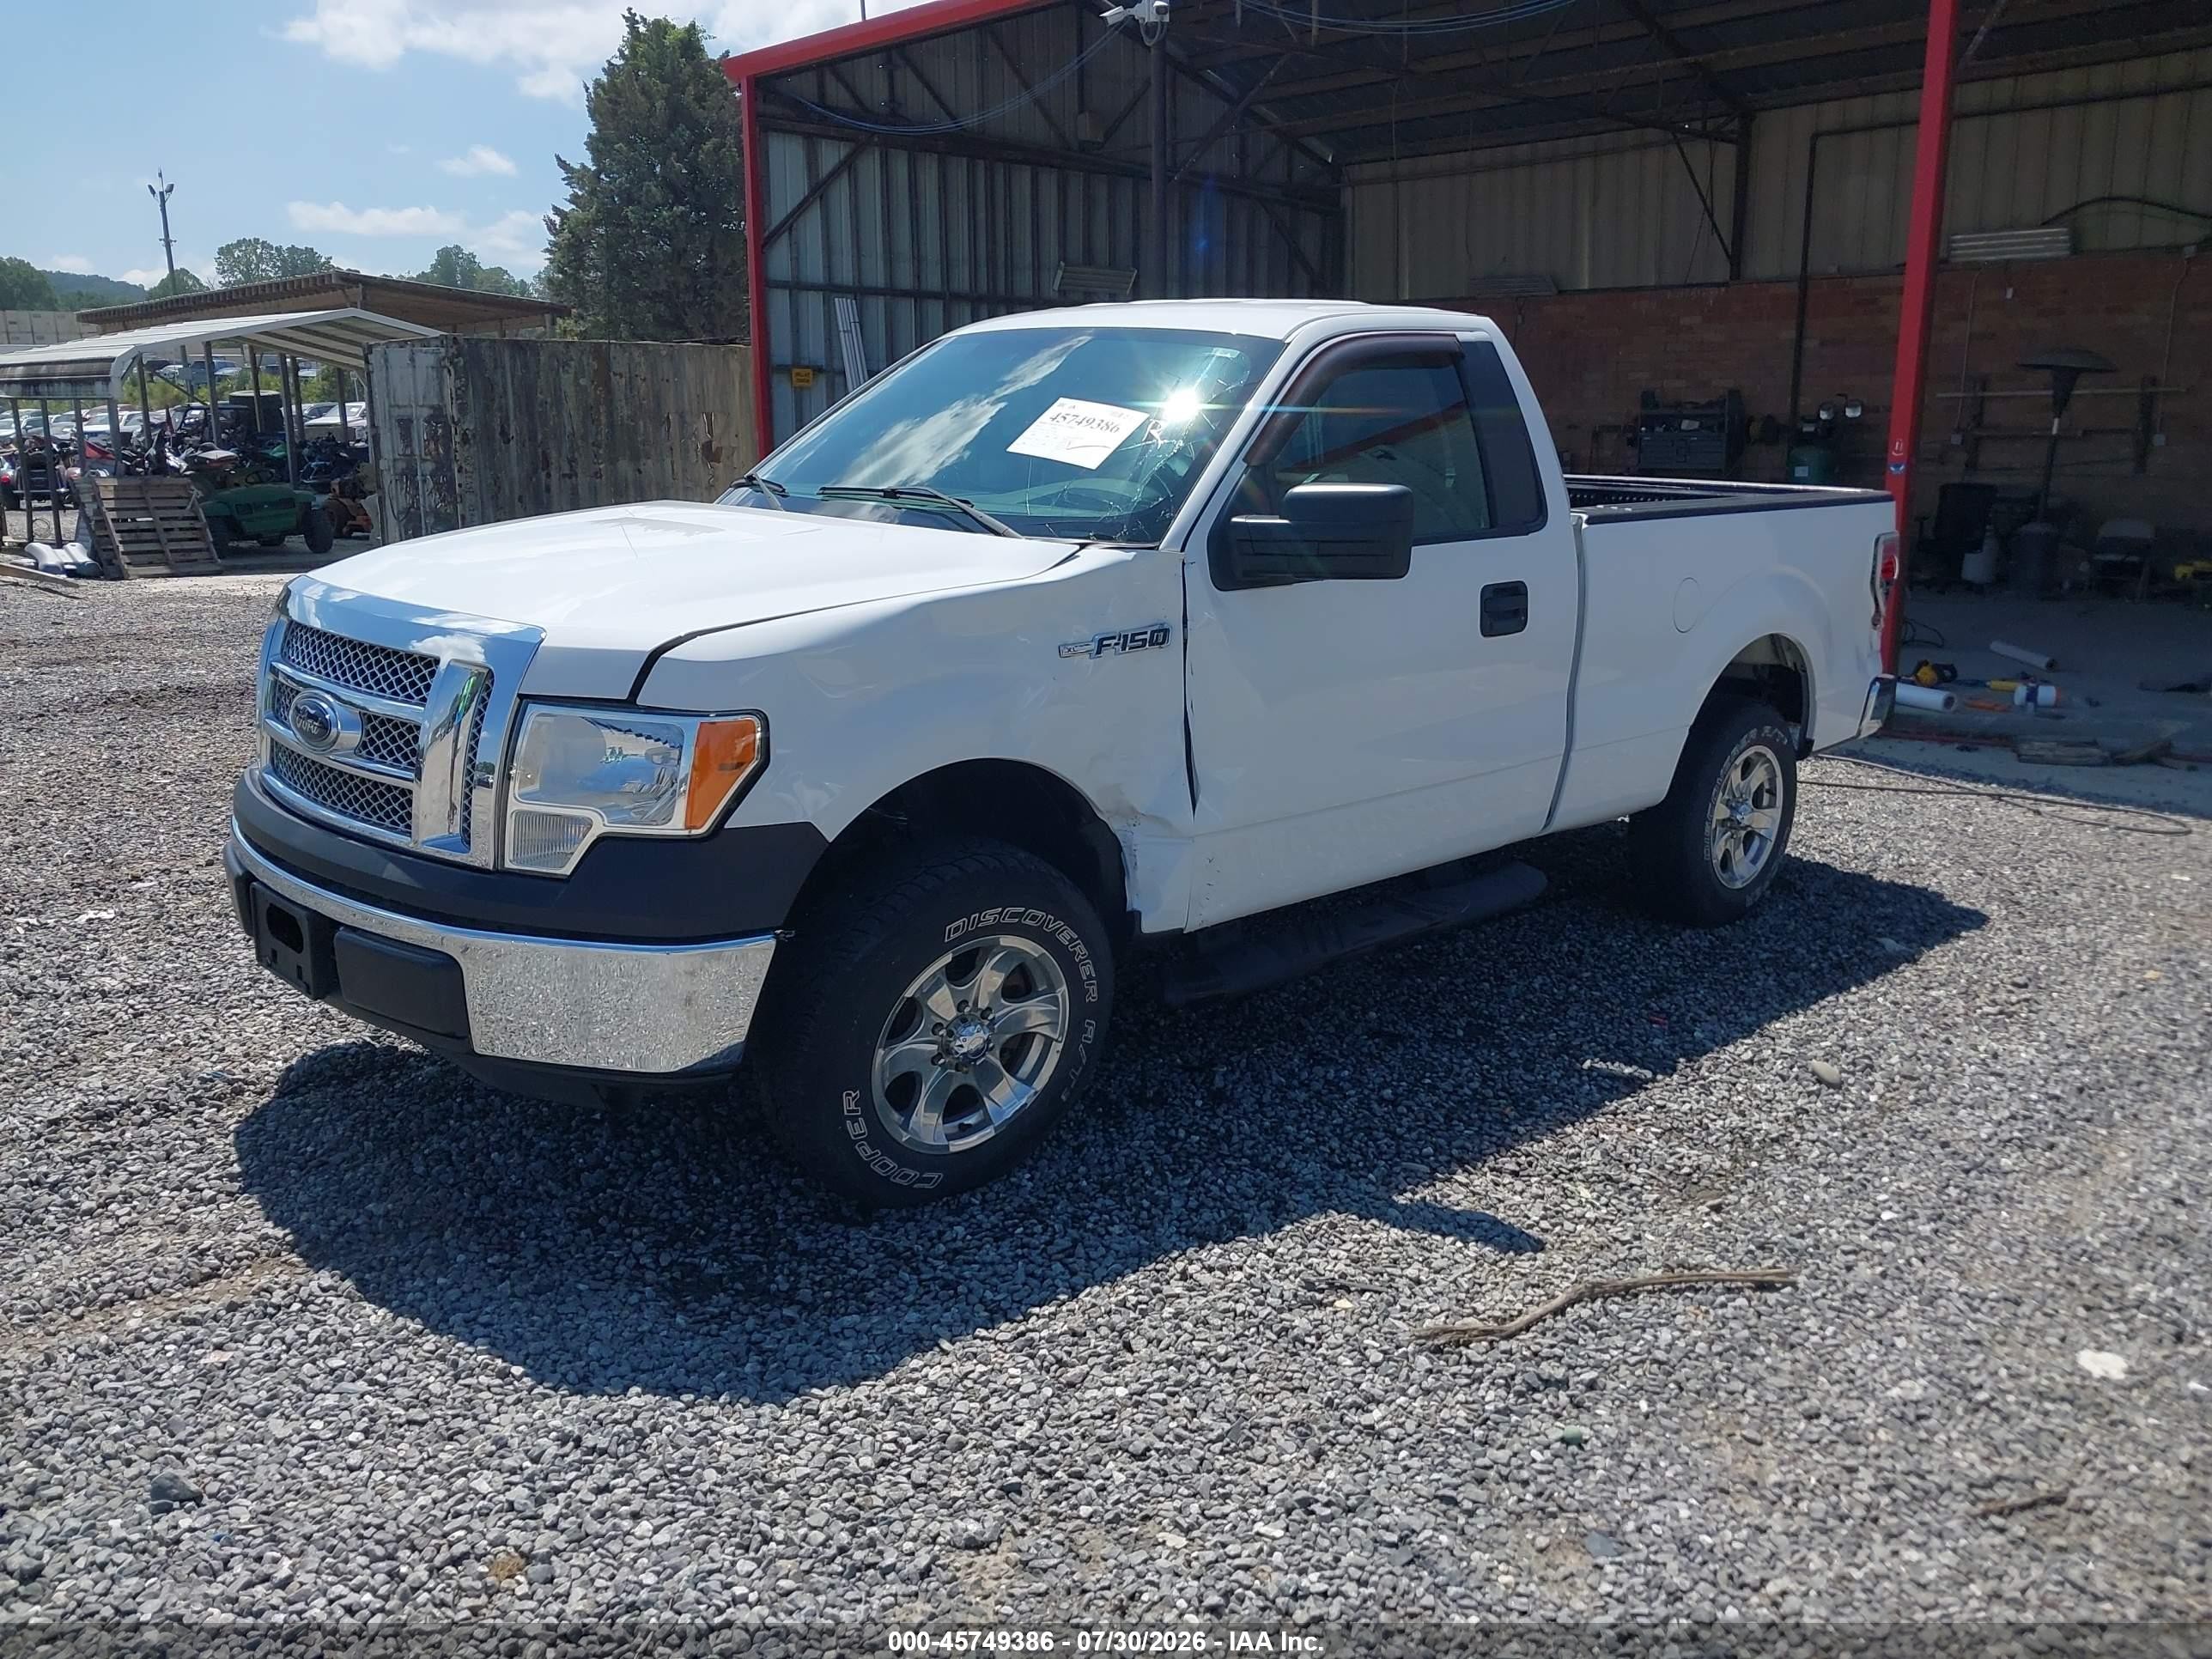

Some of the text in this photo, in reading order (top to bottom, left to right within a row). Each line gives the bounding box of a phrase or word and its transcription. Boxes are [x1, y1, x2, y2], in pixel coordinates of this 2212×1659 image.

[1048, 411, 1120, 434] 45749386
[1094, 627, 1171, 655] F-150
[295, 704, 324, 735] Ford
[945, 907, 1098, 1004] DISCOVERER
[842, 1089, 944, 1189] COOPER
